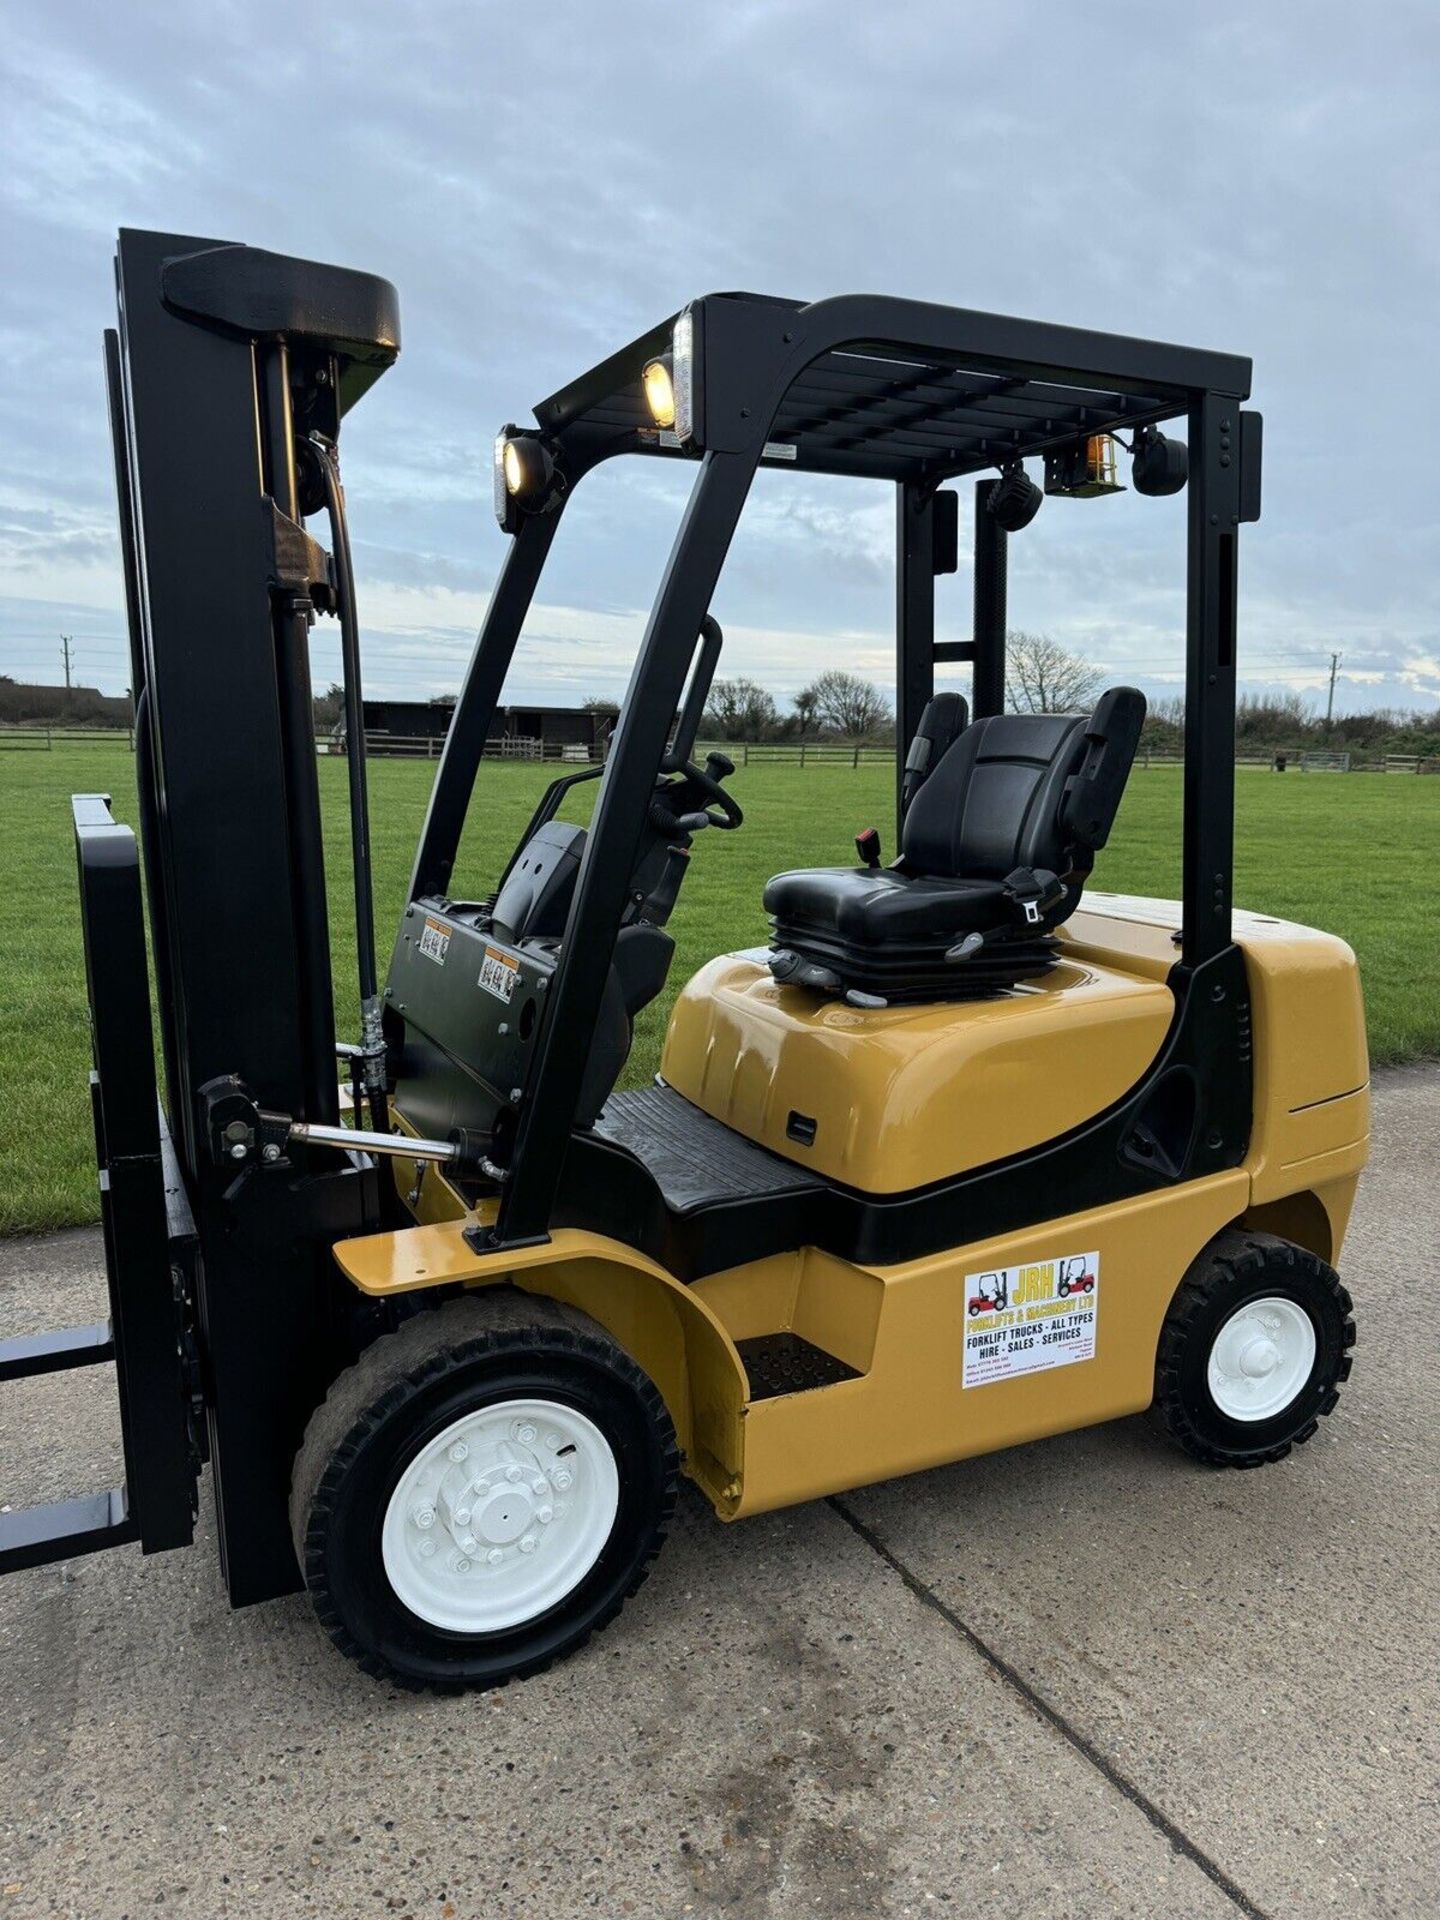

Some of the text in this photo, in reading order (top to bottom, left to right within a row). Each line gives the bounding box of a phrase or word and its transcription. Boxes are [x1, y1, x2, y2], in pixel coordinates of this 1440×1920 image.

[1012, 1263, 1054, 1304] JRH
[967, 1311, 1015, 1334] FORKLIFTS
[1079, 1295, 1094, 1310] LTD
[967, 1330, 1007, 1349] FORKLIFT
[1010, 1323, 1043, 1341] TRUCKS
[1051, 1320, 1066, 1331] ALL
[1068, 1312, 1093, 1327] TYPES
[979, 1346, 999, 1359] HIRE
[1007, 1337, 1034, 1353] SALES
[1042, 1327, 1081, 1345] SERVICES
